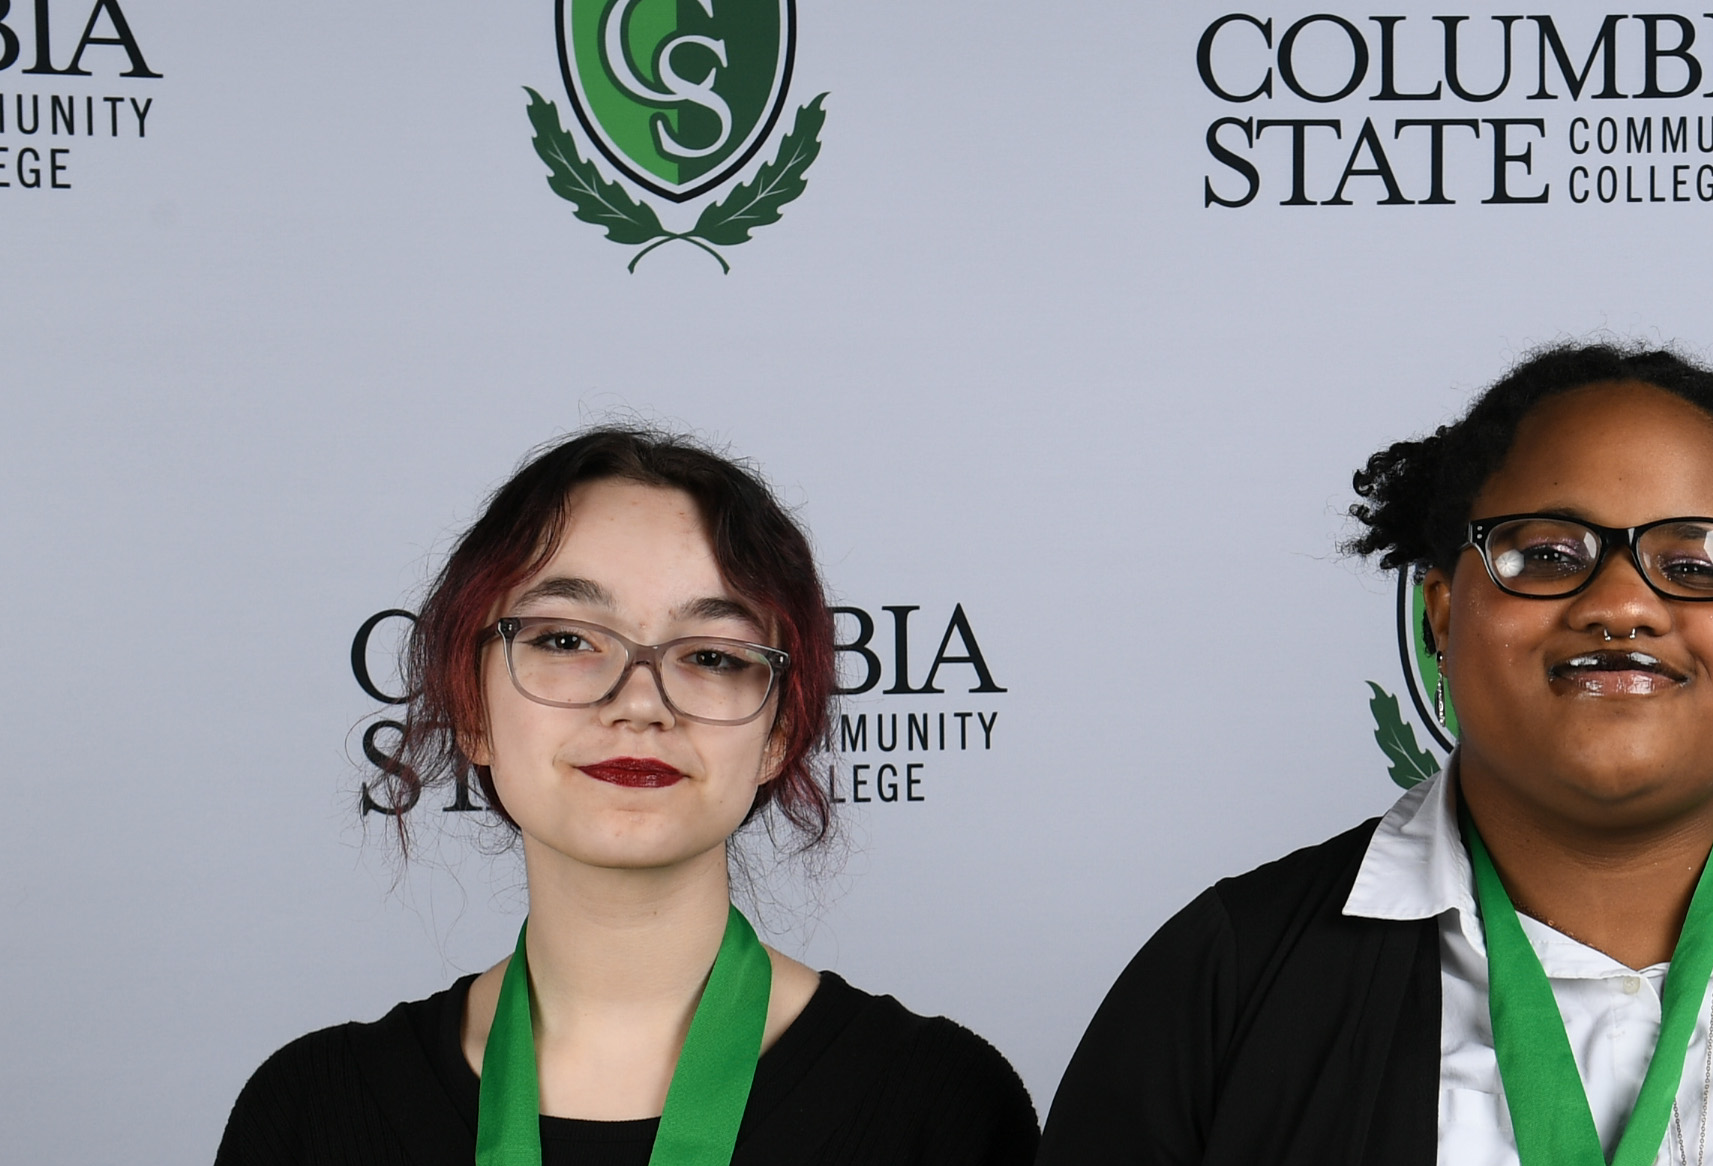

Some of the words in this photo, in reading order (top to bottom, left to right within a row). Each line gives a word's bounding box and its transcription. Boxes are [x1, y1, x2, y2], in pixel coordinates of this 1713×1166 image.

[0, 93, 153, 137] UNITY
[1204, 116, 1550, 209] STATE
[823, 711, 998, 753] MUNITY
